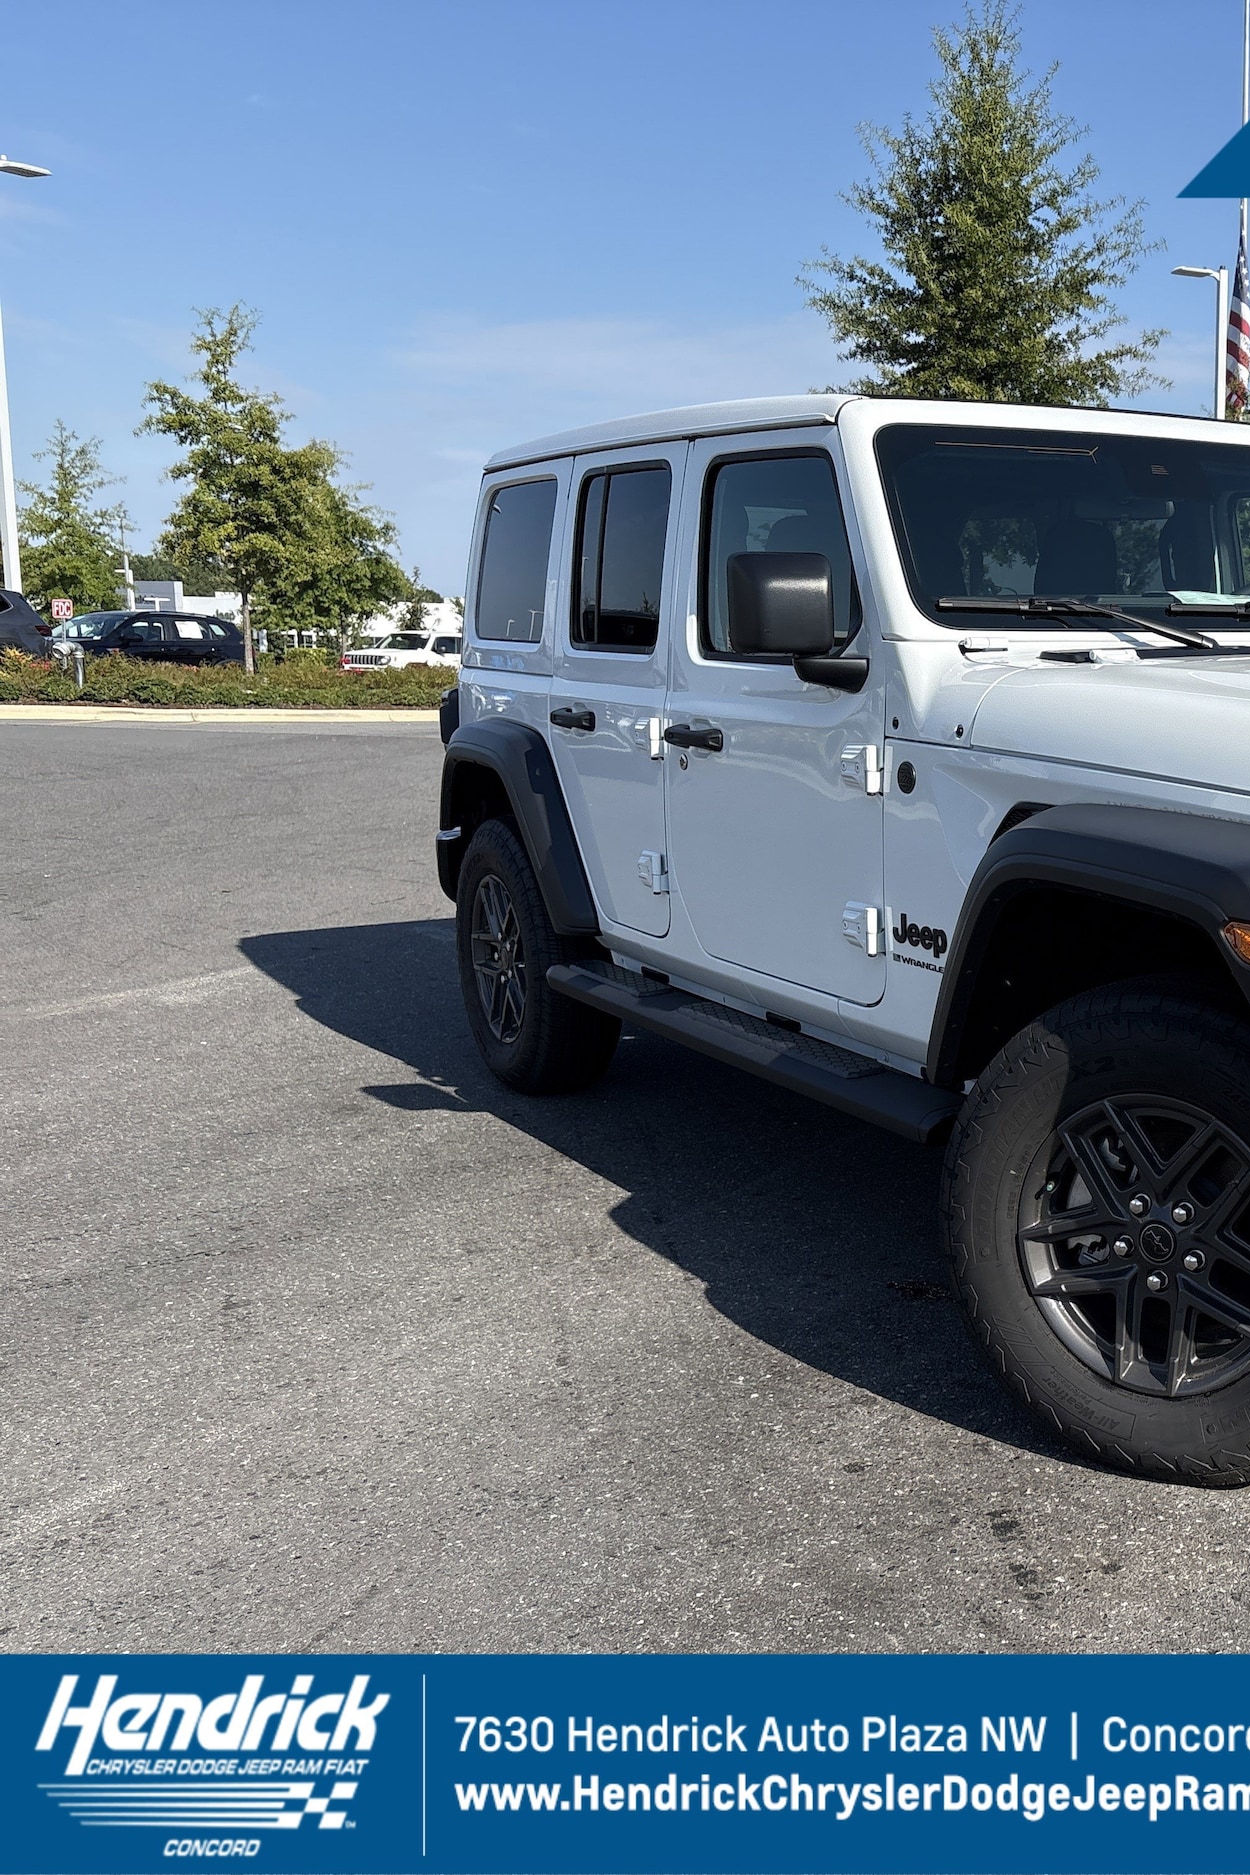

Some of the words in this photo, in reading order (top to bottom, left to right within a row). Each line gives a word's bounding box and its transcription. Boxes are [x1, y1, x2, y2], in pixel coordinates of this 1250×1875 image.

[53, 601, 72, 616] FDC
[892, 913, 948, 959] Jeep
[900, 954, 946, 975] WRANGLE
[1040, 1373, 1121, 1432] All-Weather
